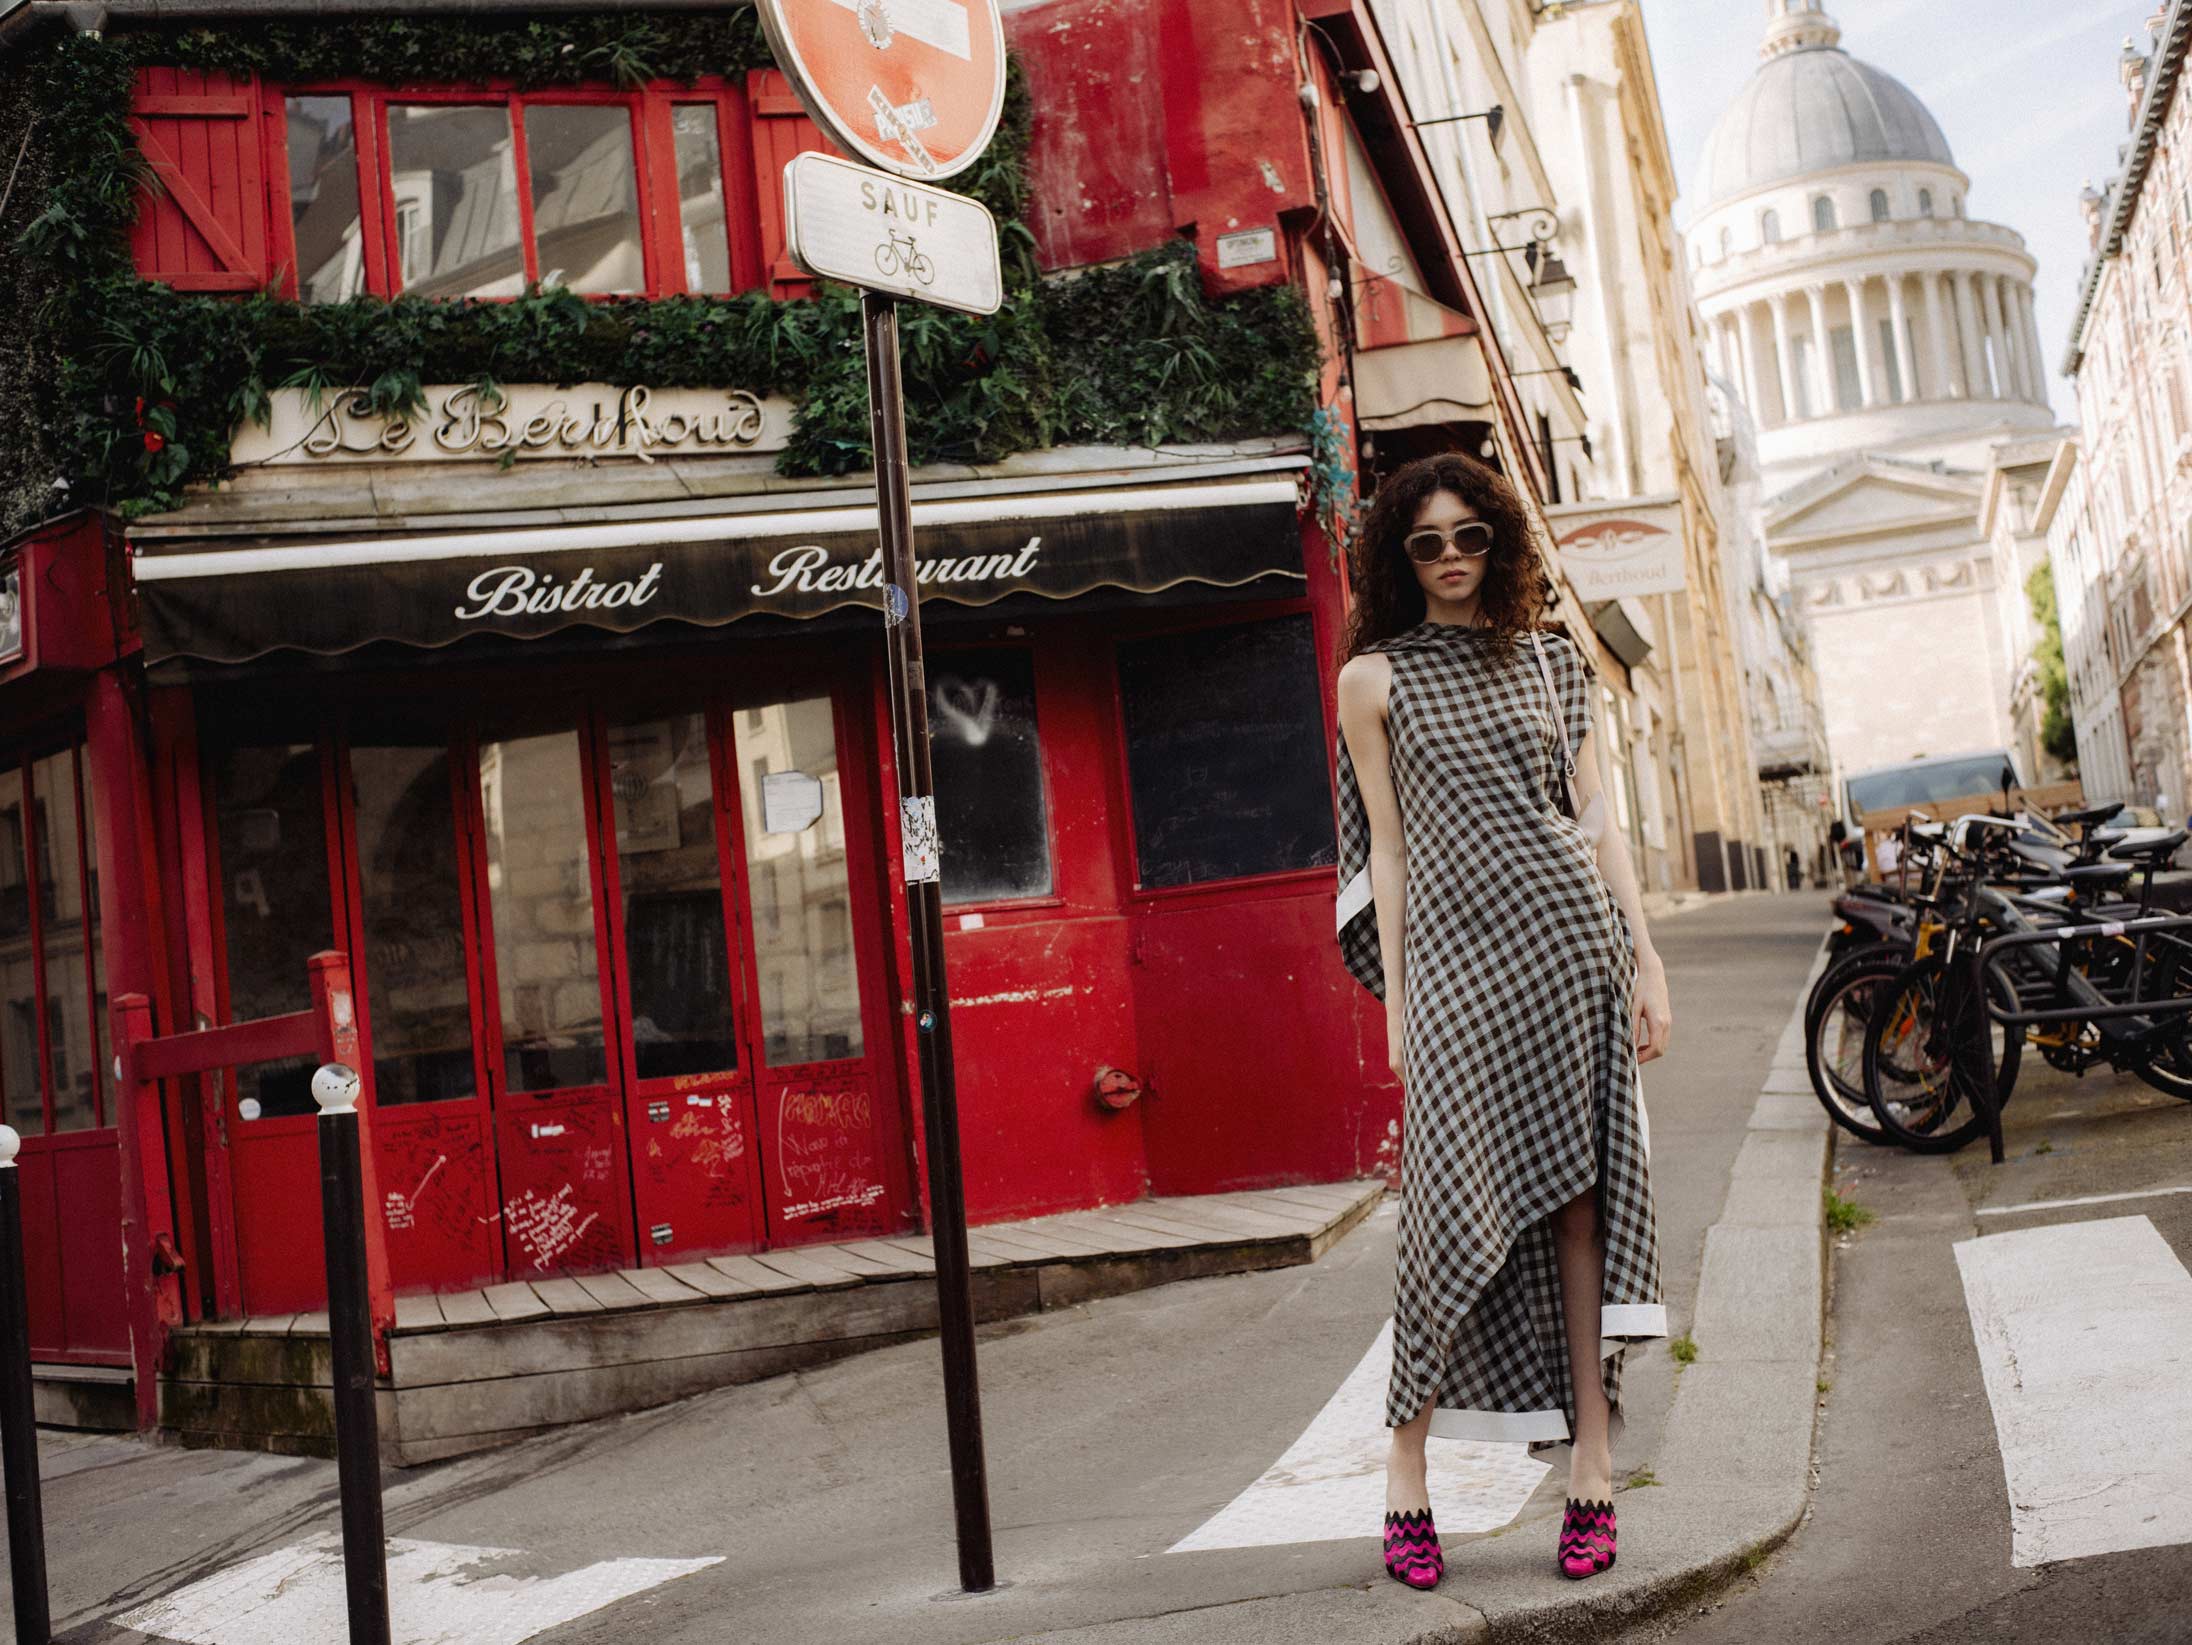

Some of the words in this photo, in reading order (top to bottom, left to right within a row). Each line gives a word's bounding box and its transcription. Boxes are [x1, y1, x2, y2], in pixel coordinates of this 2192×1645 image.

[861, 181, 938, 227] SAUF
[302, 388, 416, 455] Le
[435, 384, 766, 464] Berthoud
[454, 562, 664, 620] Bistrot
